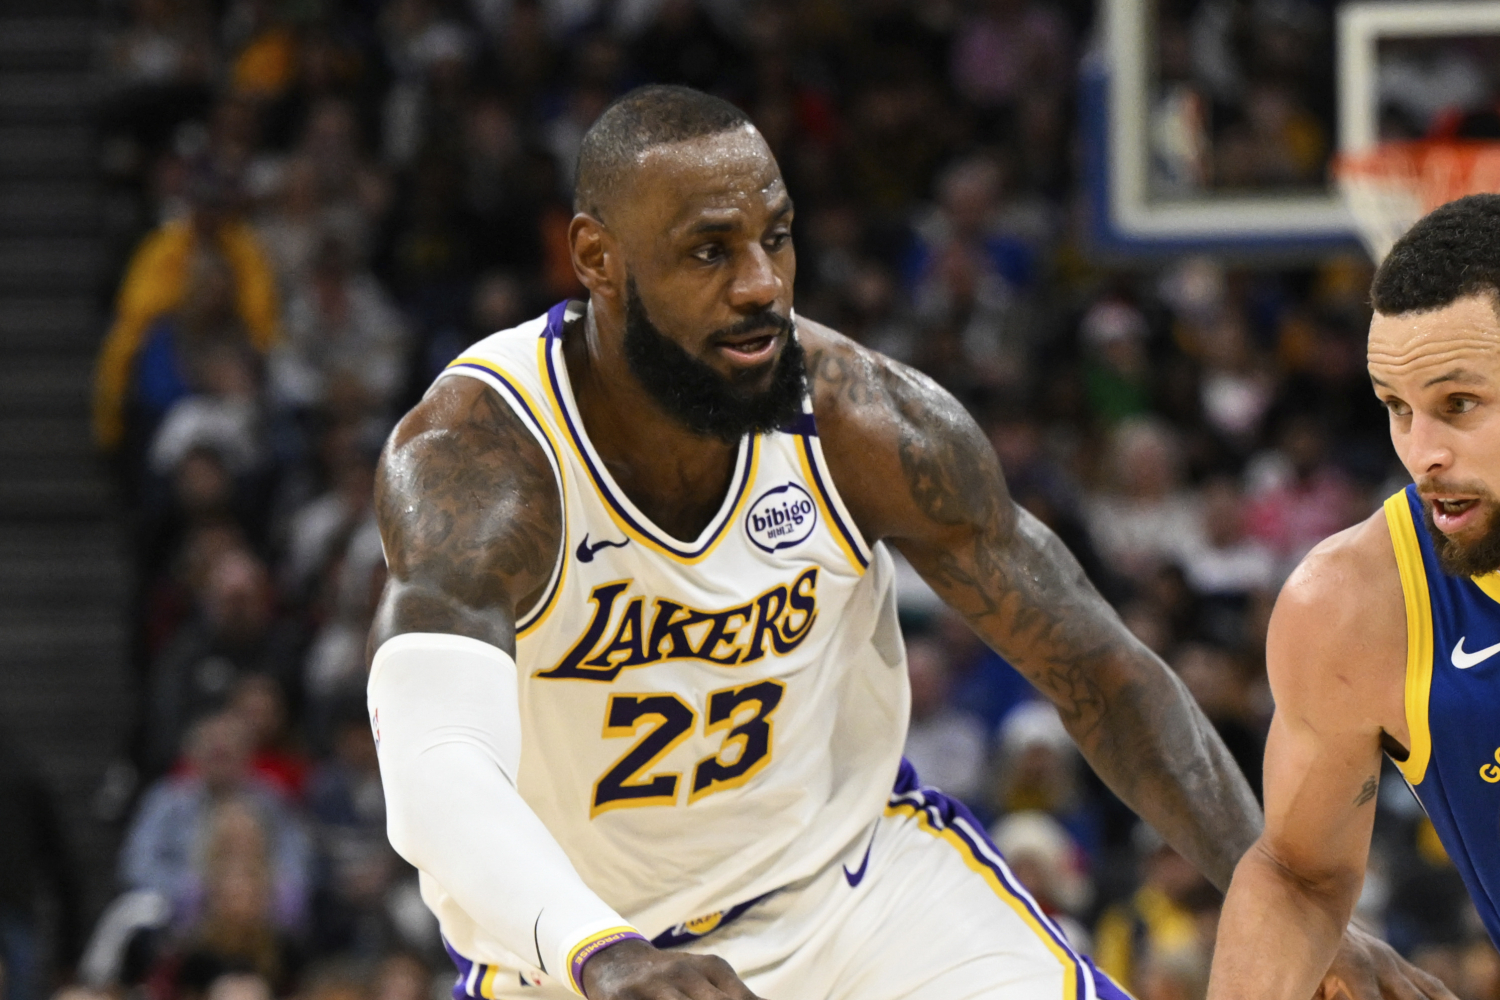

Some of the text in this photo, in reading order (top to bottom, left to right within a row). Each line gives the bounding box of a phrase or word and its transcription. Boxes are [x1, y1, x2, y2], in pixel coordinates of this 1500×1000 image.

[752, 500, 811, 532] bibigo
[767, 523, 794, 539] 비비고
[531, 566, 820, 682] LAKERS
[589, 677, 786, 820] 23
[575, 934, 620, 965] PROMISE
